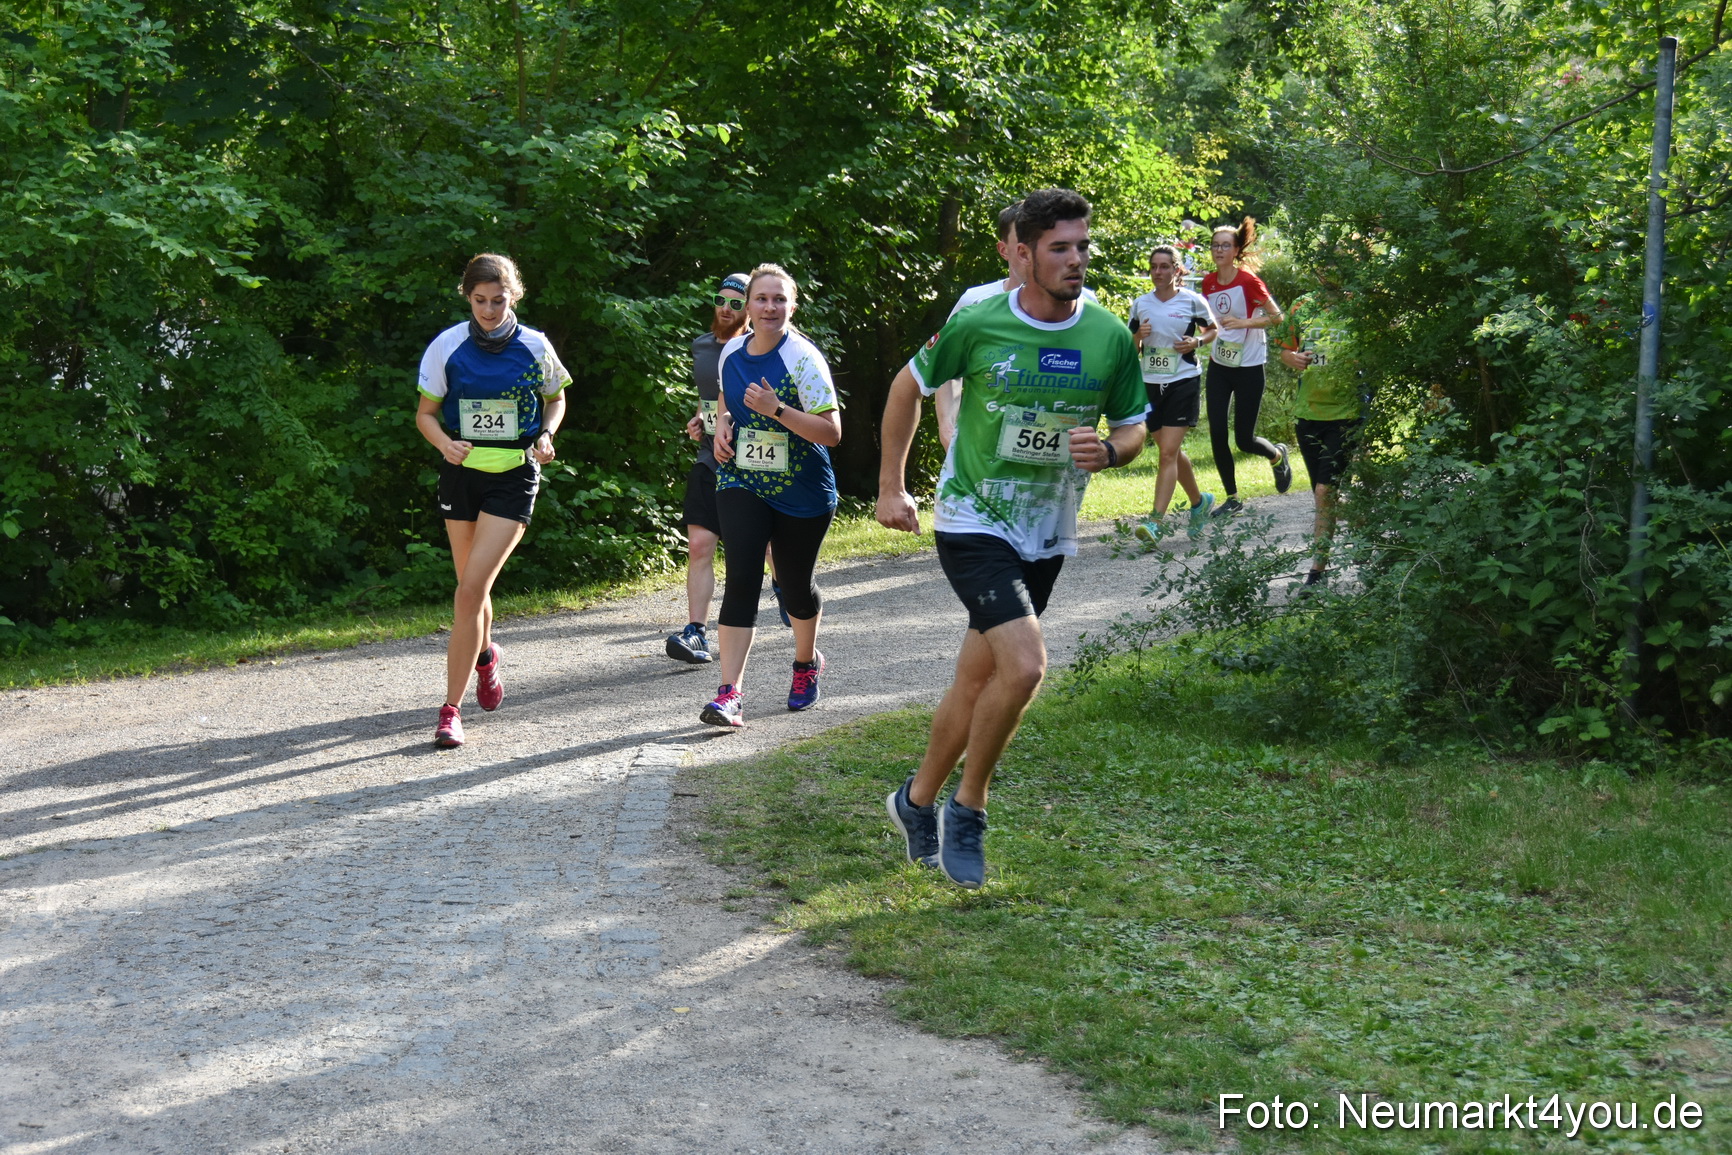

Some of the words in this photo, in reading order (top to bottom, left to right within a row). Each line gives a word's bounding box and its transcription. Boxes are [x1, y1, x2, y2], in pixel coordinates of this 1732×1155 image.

[1216, 346, 1238, 360] 1897
[1047, 358, 1079, 367] Fischer
[1149, 356, 1169, 368] 966
[1016, 387, 1060, 395] neumarkt
[472, 414, 505, 429] 234
[1016, 428, 1061, 451] 564
[745, 444, 776, 461] 214
